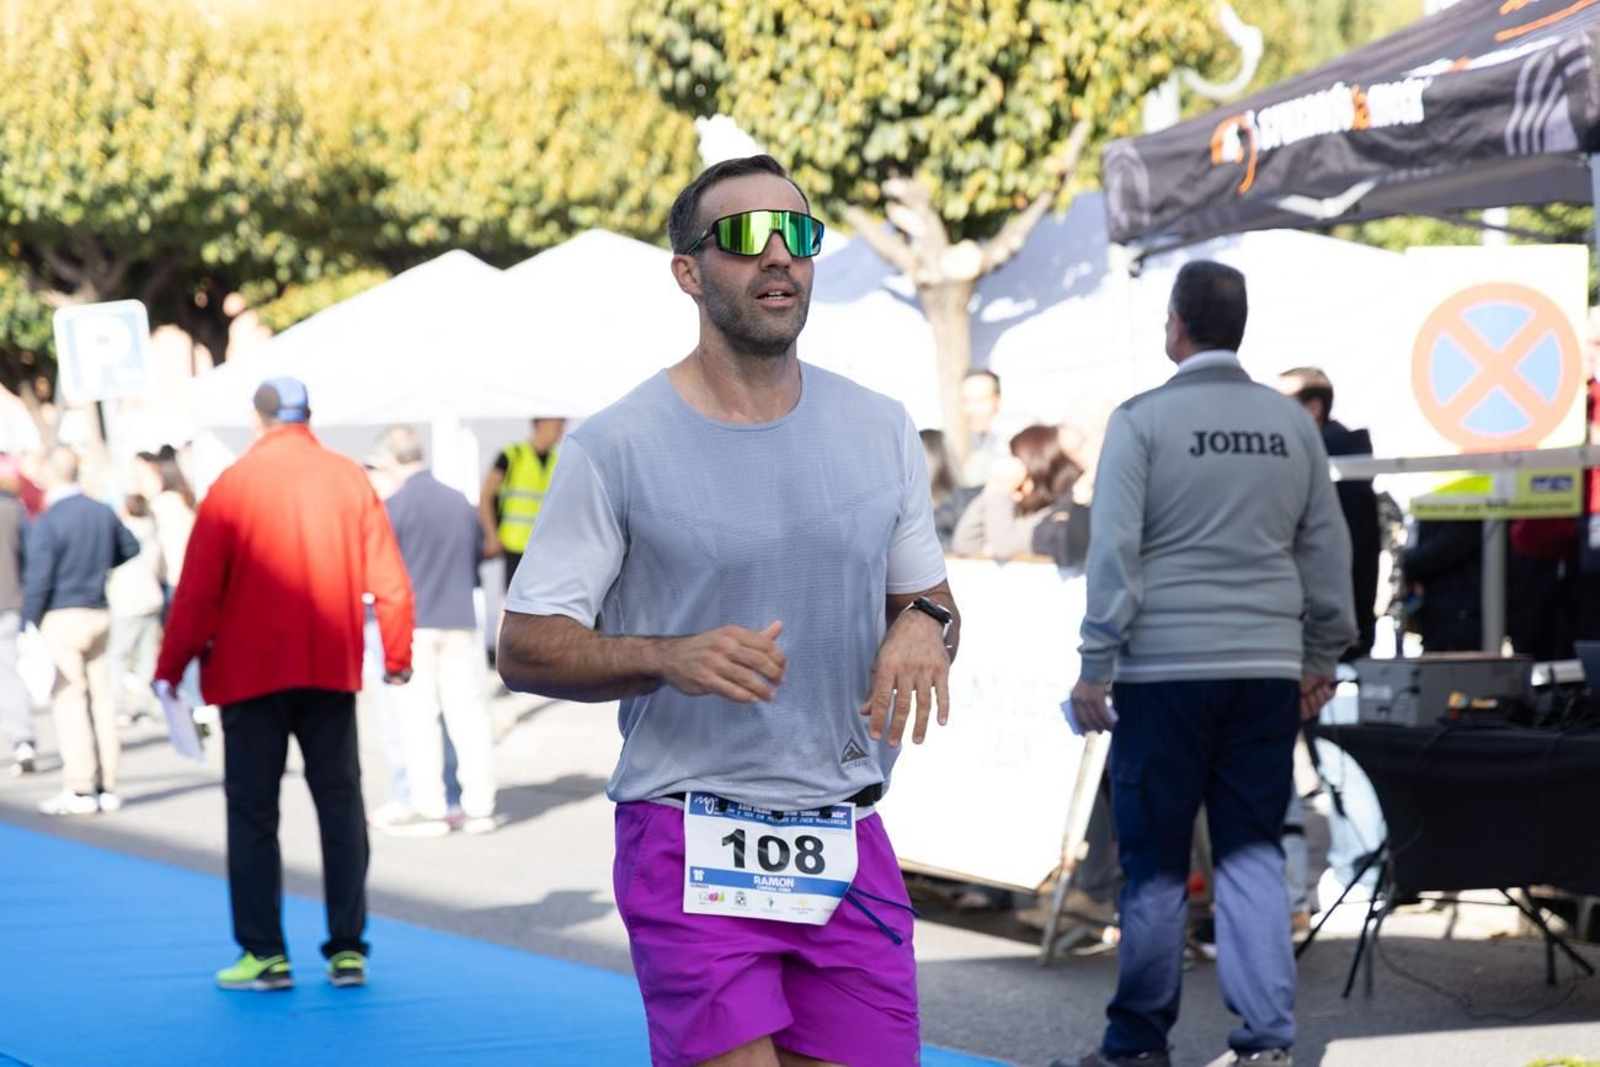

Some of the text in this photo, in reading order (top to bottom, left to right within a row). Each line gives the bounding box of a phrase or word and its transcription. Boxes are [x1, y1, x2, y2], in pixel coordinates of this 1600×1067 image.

[76, 315, 131, 392] P
[722, 828, 826, 875] 108
[754, 875, 795, 887] RAMON
